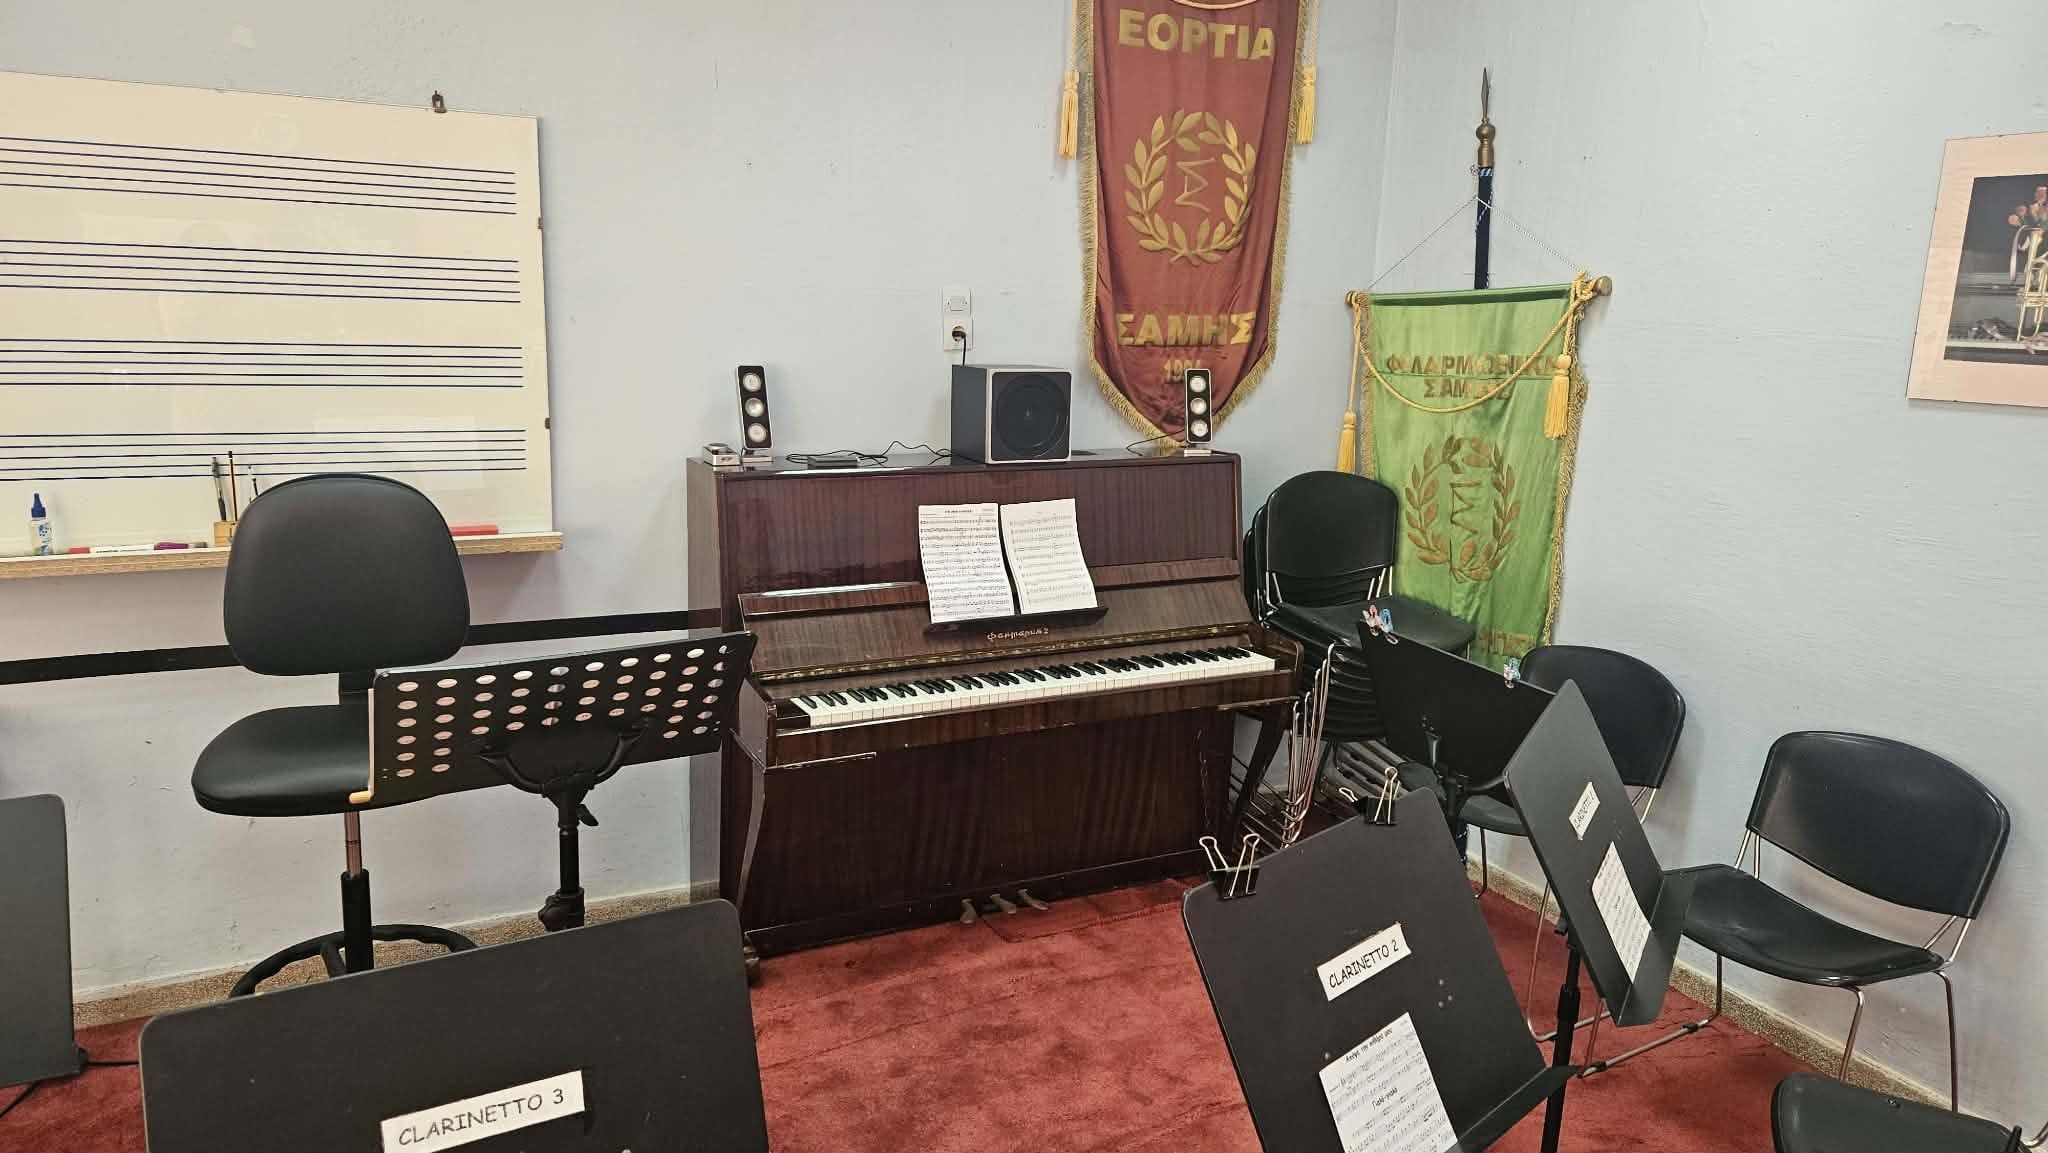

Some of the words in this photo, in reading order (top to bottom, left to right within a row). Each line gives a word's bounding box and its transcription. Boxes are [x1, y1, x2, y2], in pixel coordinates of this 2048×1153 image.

[1119, 9, 1275, 60] ΕΟΡΤΙΑ
[1116, 312, 1256, 345] ΣΑΜΗΣ
[1329, 945, 1390, 988] CLARINETTO
[1392, 939, 1399, 952] 2
[398, 1094, 543, 1146] CLARINETTO
[552, 1088, 564, 1105] 3
